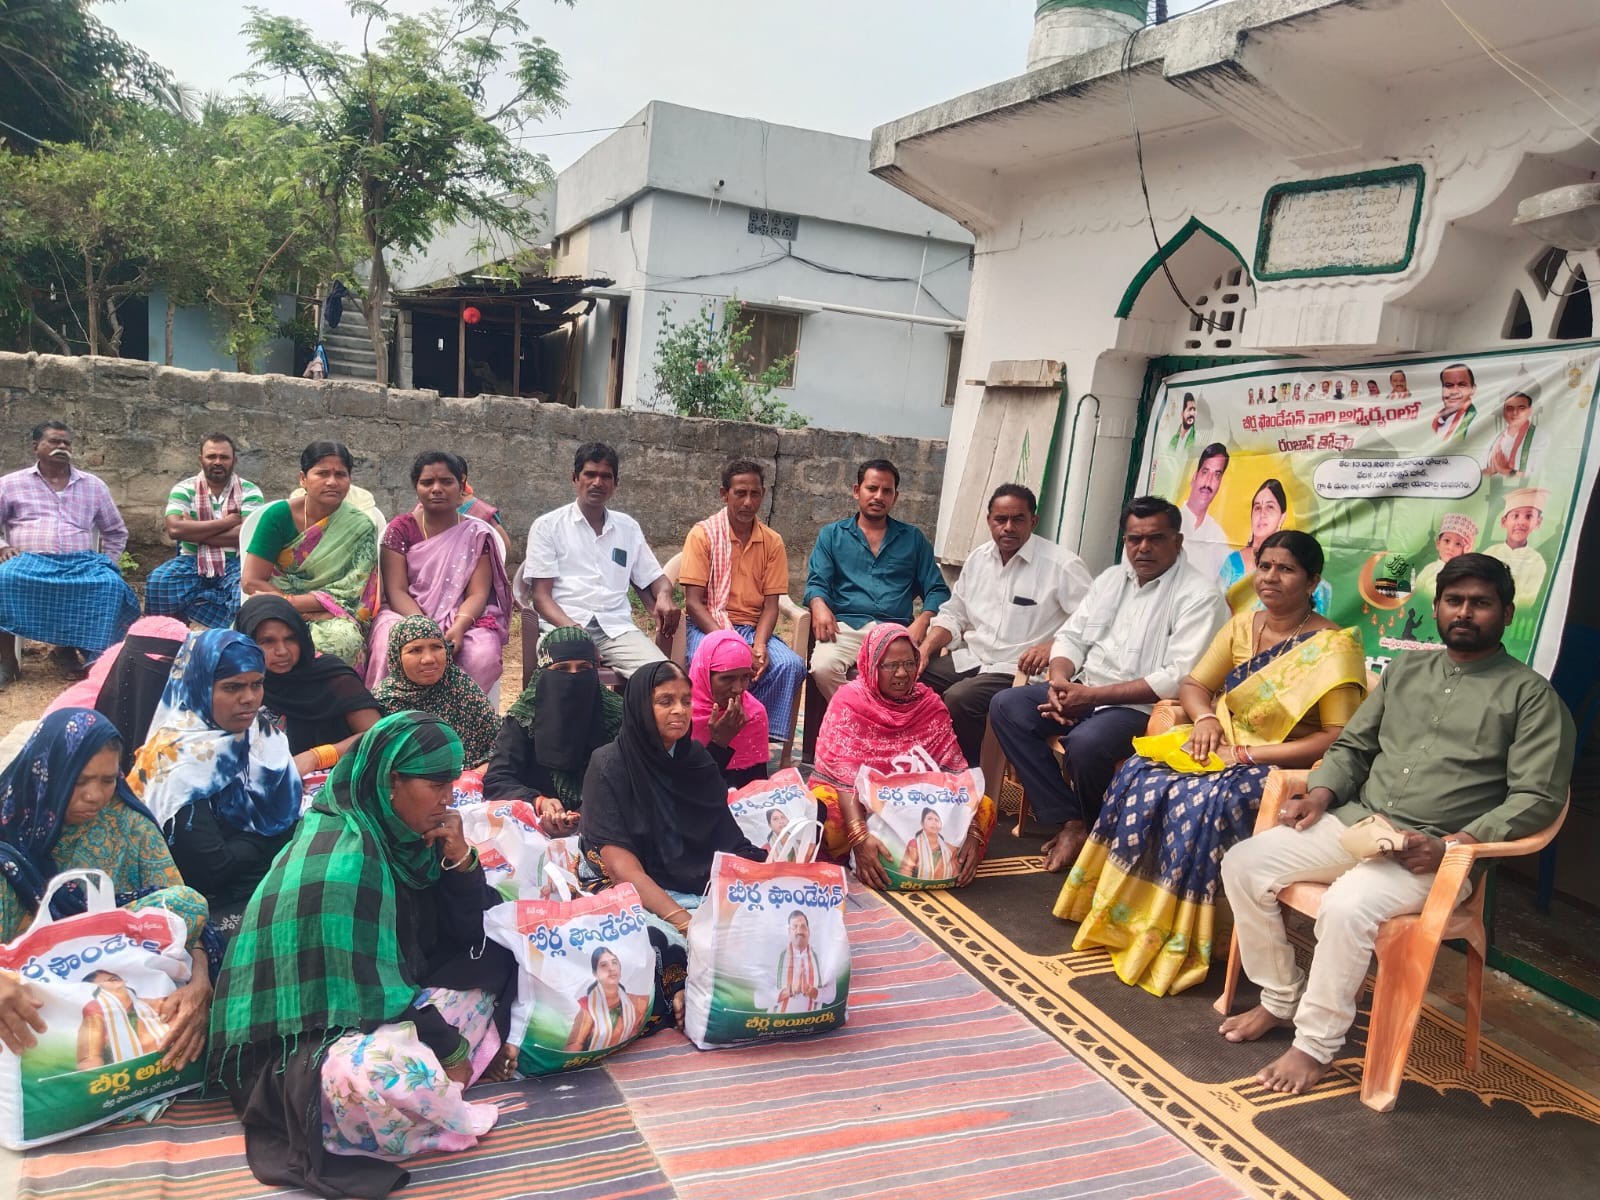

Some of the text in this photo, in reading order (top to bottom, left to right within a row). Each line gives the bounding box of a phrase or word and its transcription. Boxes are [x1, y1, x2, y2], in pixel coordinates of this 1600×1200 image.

[1258, 409, 1305, 431] ఫౌండేషన్
[1308, 410, 1335, 425] వారి
[878, 787, 905, 806] బీర్ల
[728, 880, 844, 911] బీర్ల ఫౌండేషన్
[528, 904, 646, 958] బీర్ల ఫౌండేషన్
[745, 1011, 836, 1031] బీర్ల అయిలయ్య
[89, 1068, 131, 1095] బీర్ల
